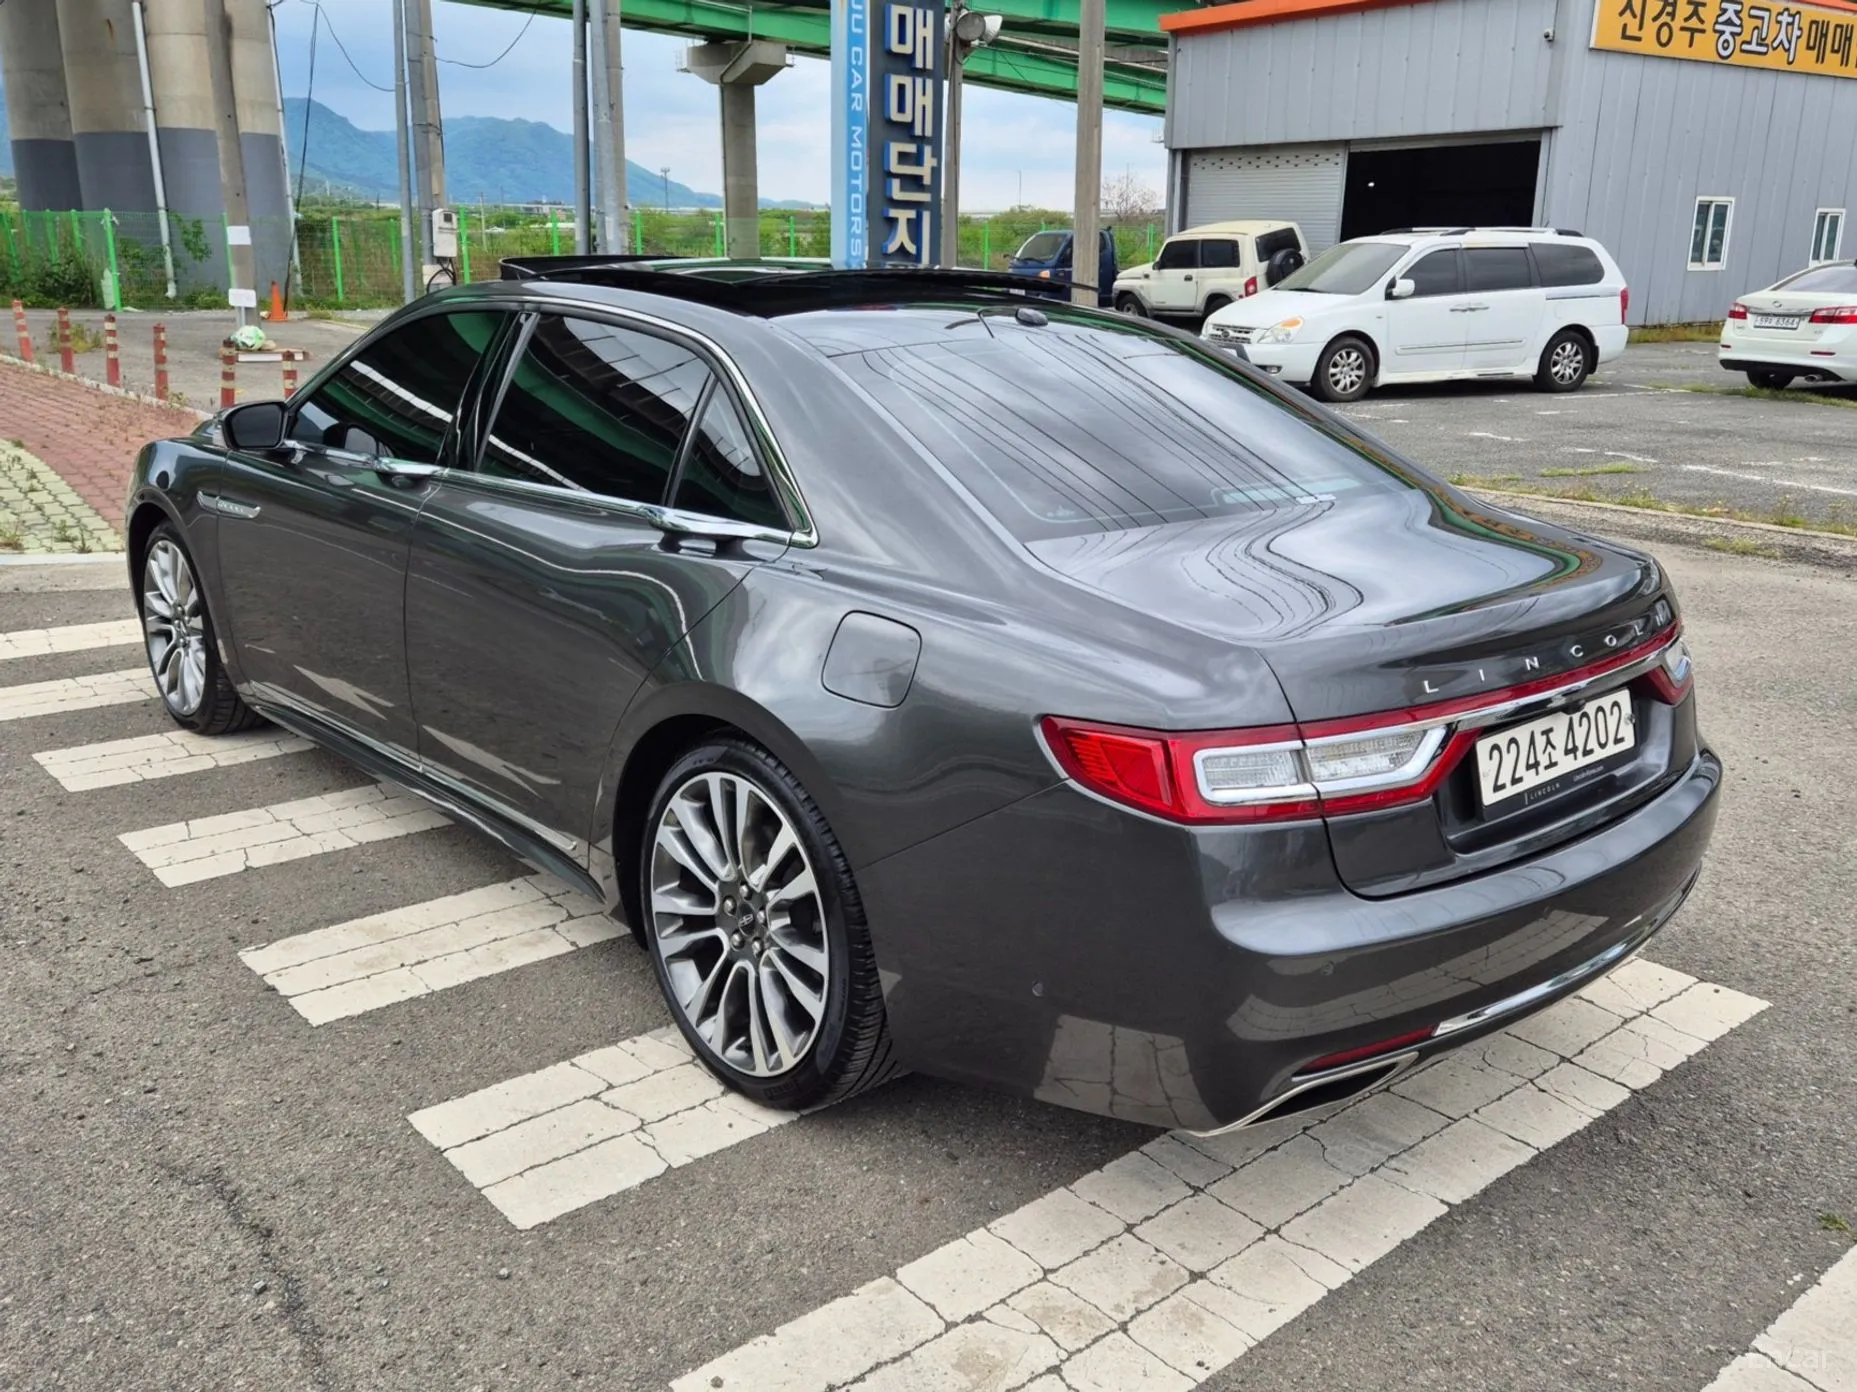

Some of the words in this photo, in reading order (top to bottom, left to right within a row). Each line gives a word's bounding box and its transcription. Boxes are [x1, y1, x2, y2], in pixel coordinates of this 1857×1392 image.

[851, 46, 863, 112] CAR
[1713, 1, 1803, 65] 중고차
[1806, 19, 1857, 69] 매매
[884, 3, 938, 265] 매매단지
[850, 126, 864, 257] MOTORS
[1489, 727, 1559, 794] 224조
[1563, 700, 1626, 761] 4202
